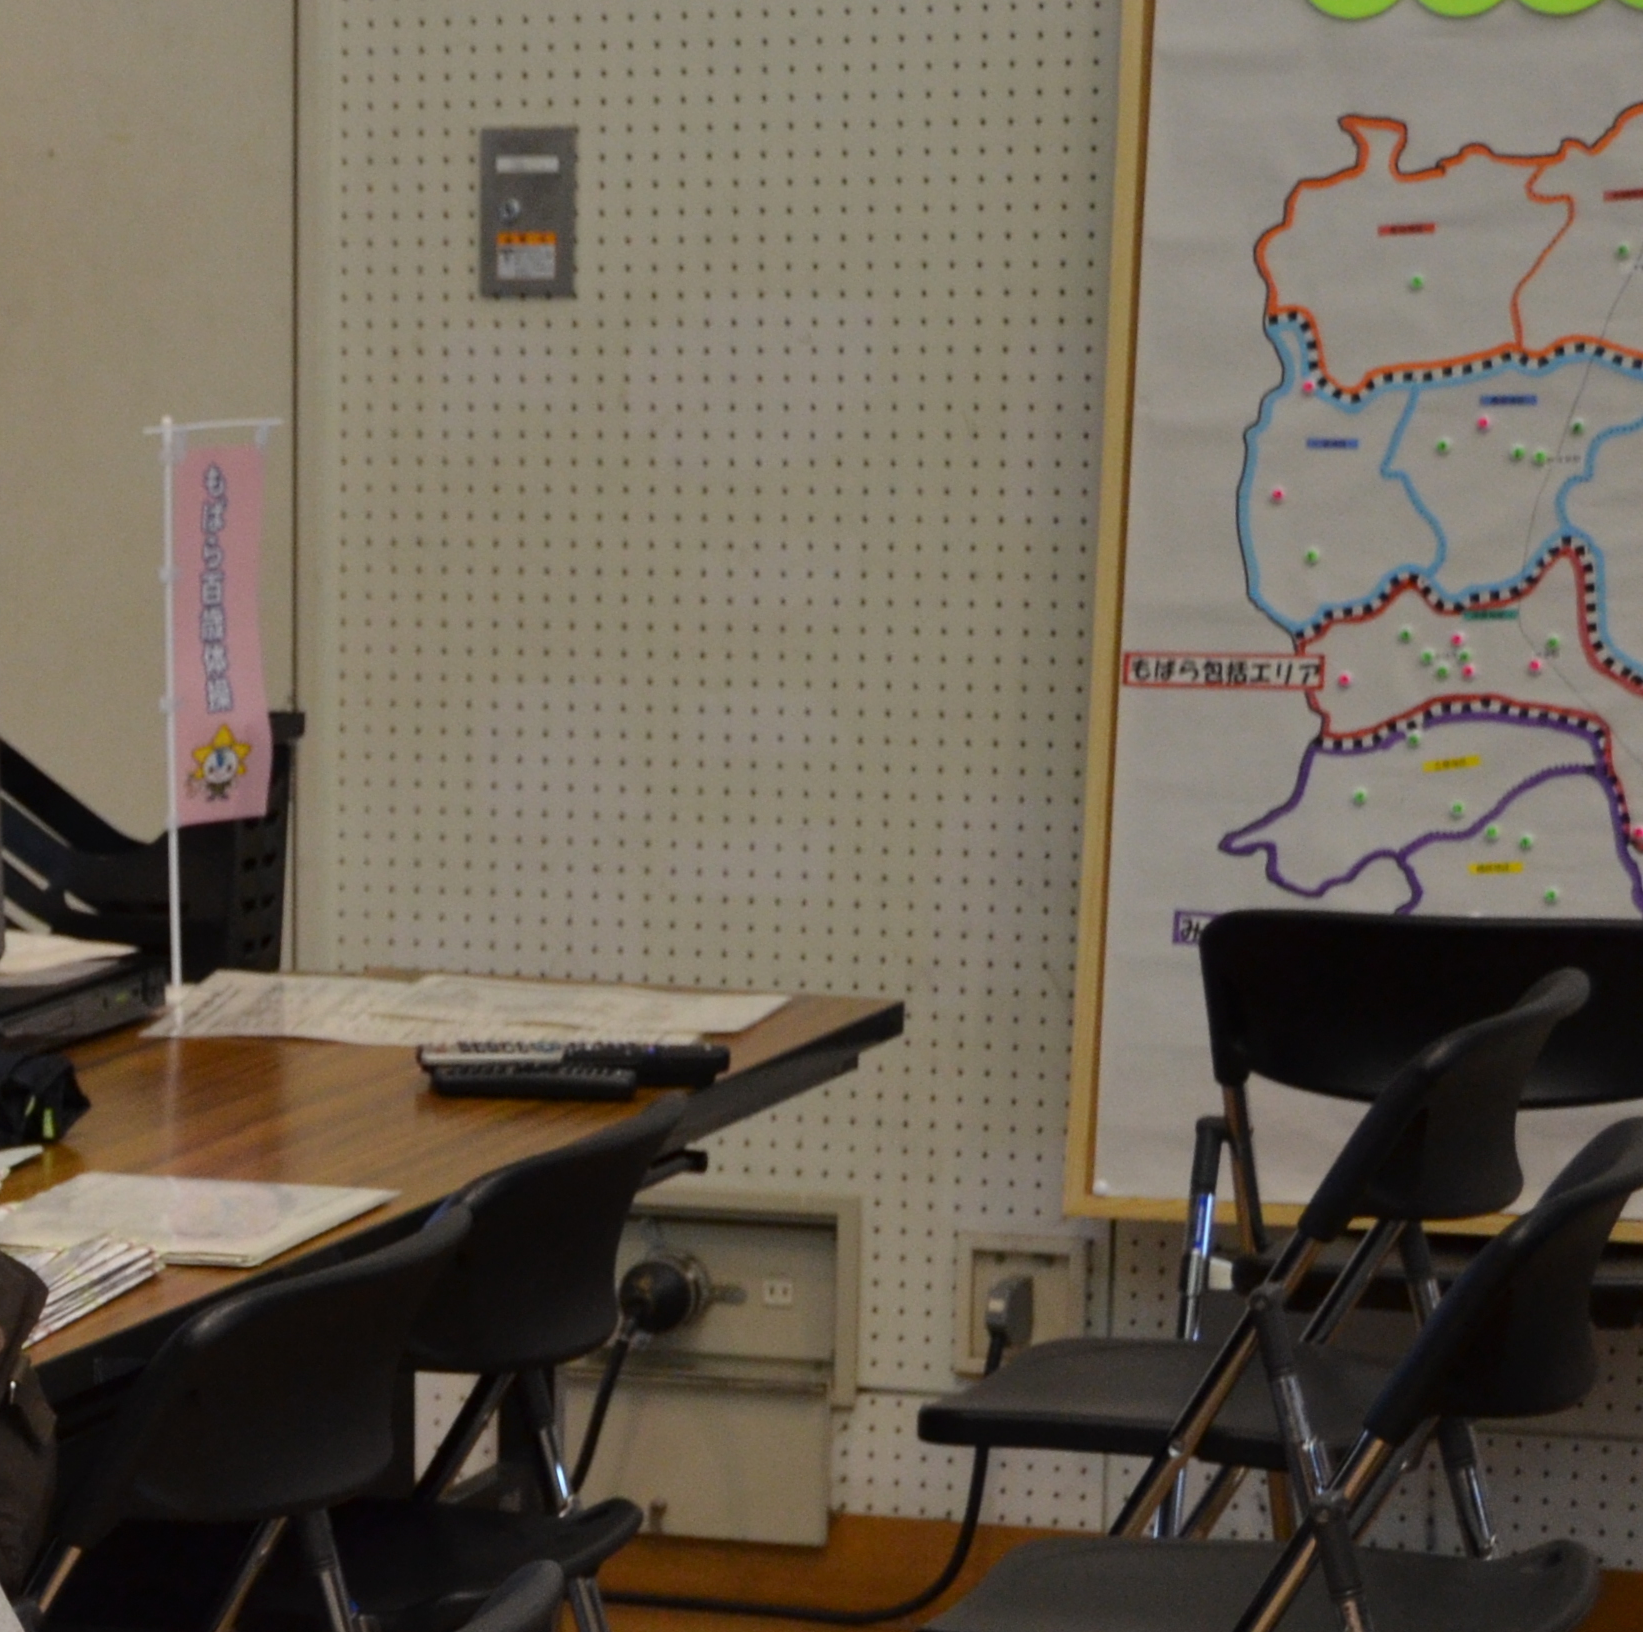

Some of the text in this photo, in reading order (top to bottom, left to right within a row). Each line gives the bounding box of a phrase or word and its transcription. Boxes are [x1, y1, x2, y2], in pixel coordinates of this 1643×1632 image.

[199, 463, 234, 714] もばら百歳体操
[1132, 659, 1320, 686] もばら包括エリア
